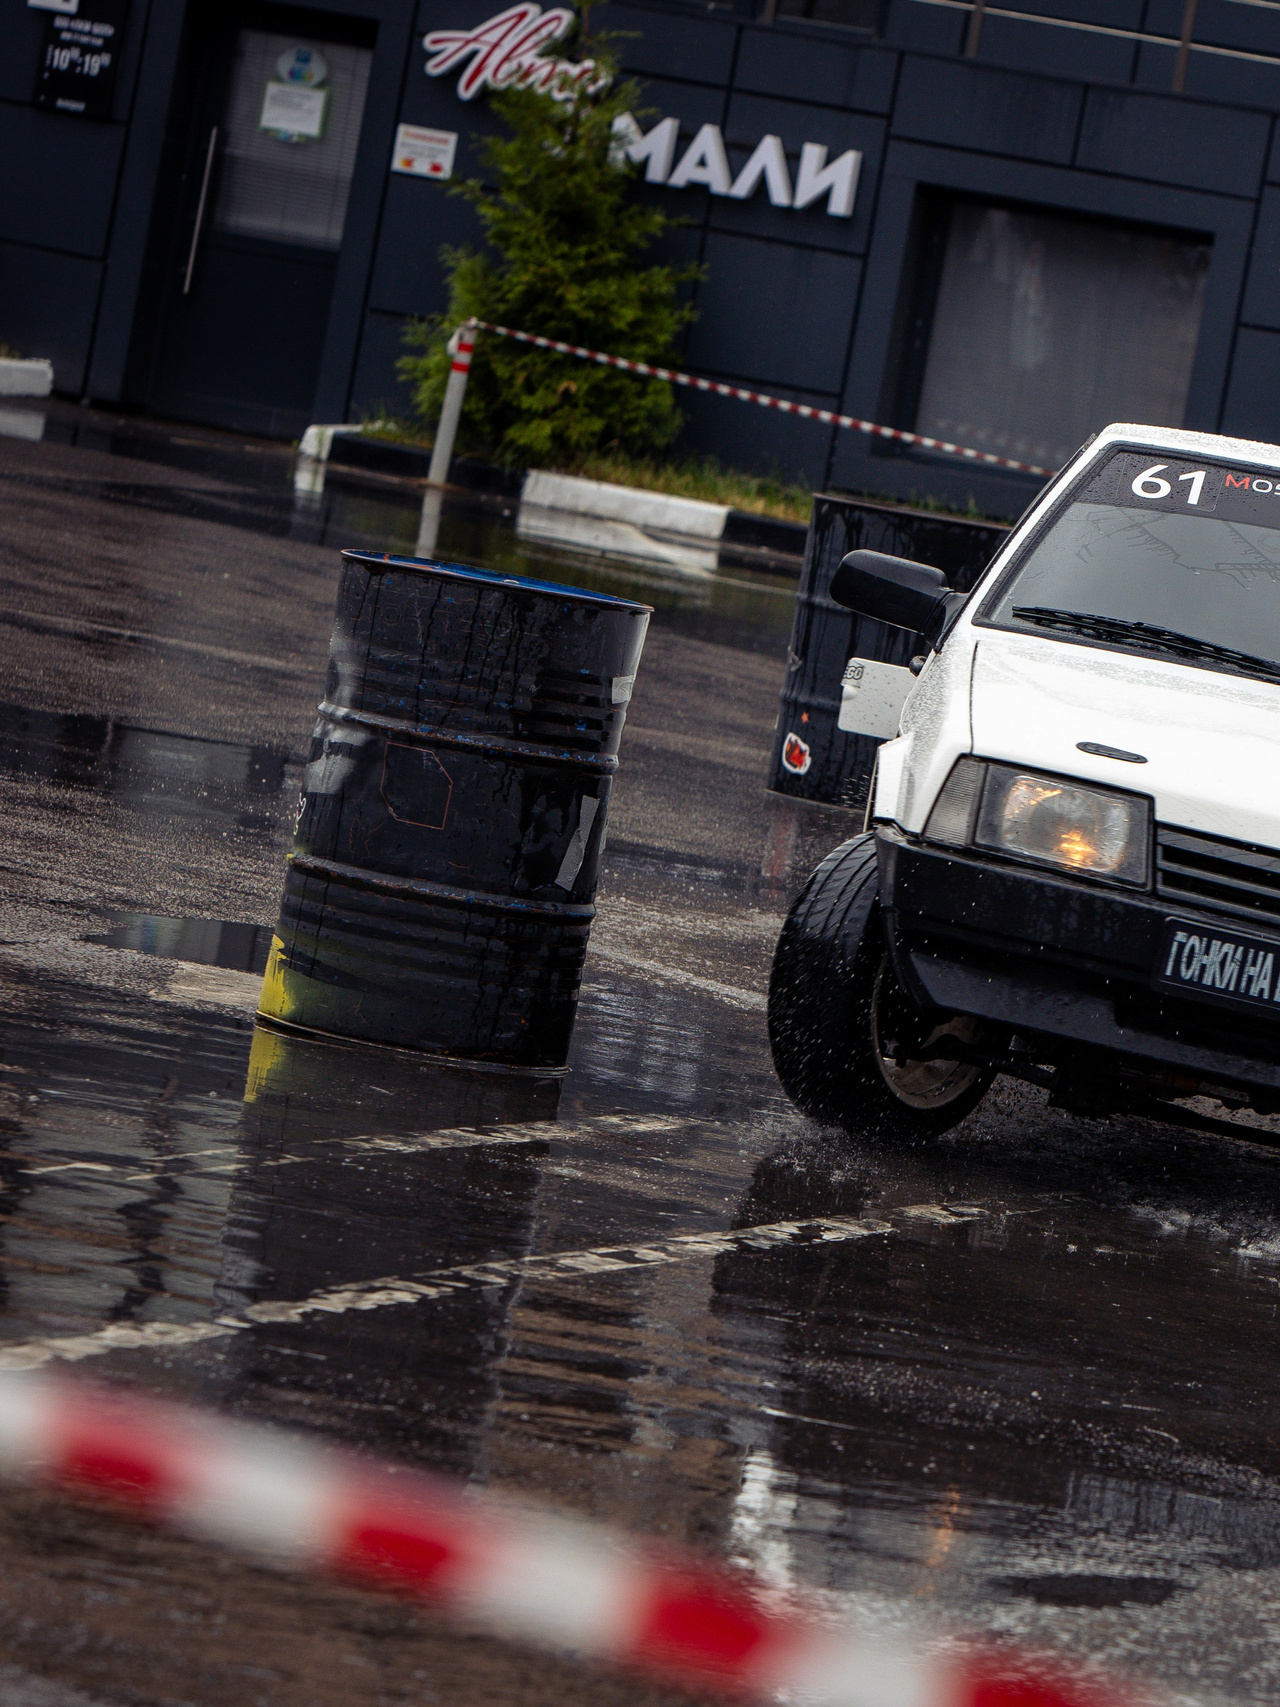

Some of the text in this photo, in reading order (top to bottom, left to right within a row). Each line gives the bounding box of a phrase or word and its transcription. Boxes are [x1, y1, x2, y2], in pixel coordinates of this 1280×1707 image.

[1131, 464, 1208, 506] 61
[1165, 931, 1244, 991] ГОНКИ
[1239, 948, 1275, 1000] НА
